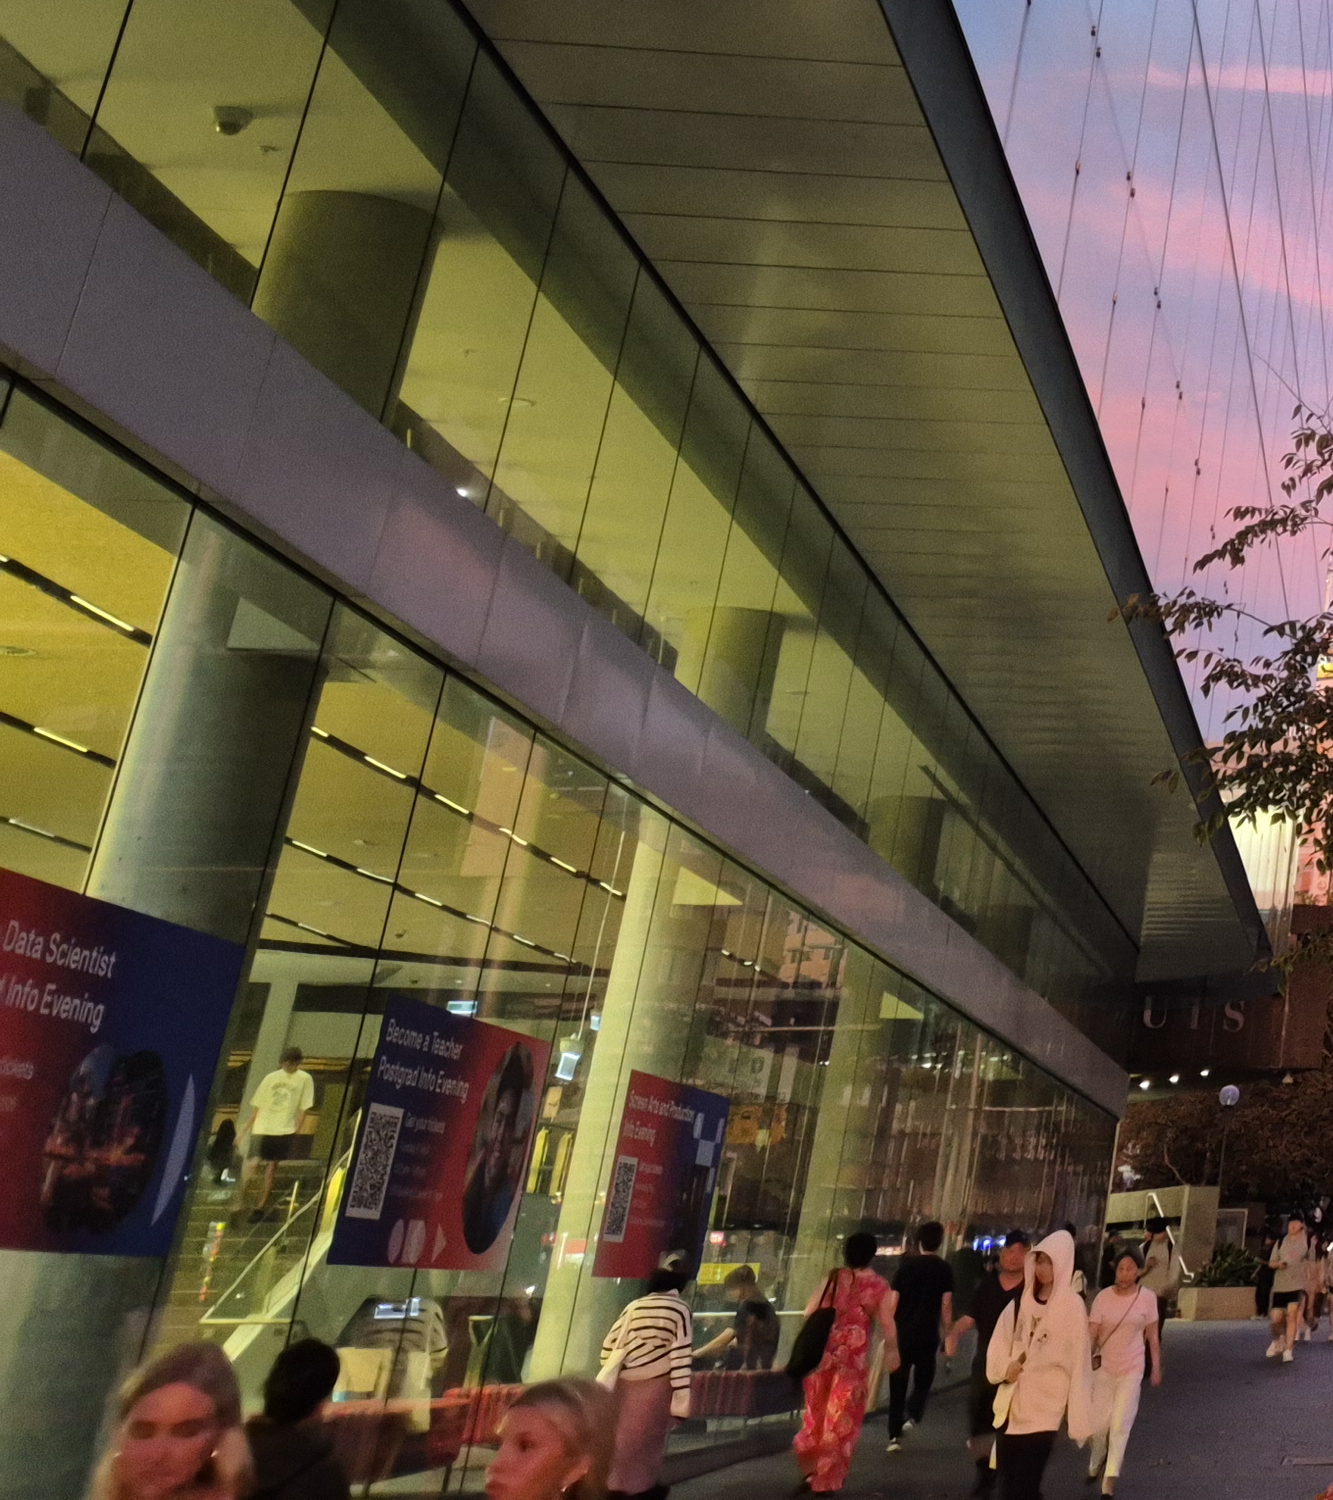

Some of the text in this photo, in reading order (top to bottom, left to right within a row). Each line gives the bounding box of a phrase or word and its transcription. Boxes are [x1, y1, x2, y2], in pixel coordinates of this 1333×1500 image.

[3, 919, 117, 979] Data Scientist
[7, 975, 106, 1034] Info Evening
[385, 1018, 424, 1049] Become
[430, 1031, 465, 1060] Teacher
[377, 1055, 470, 1104] Postgrad Info Evening
